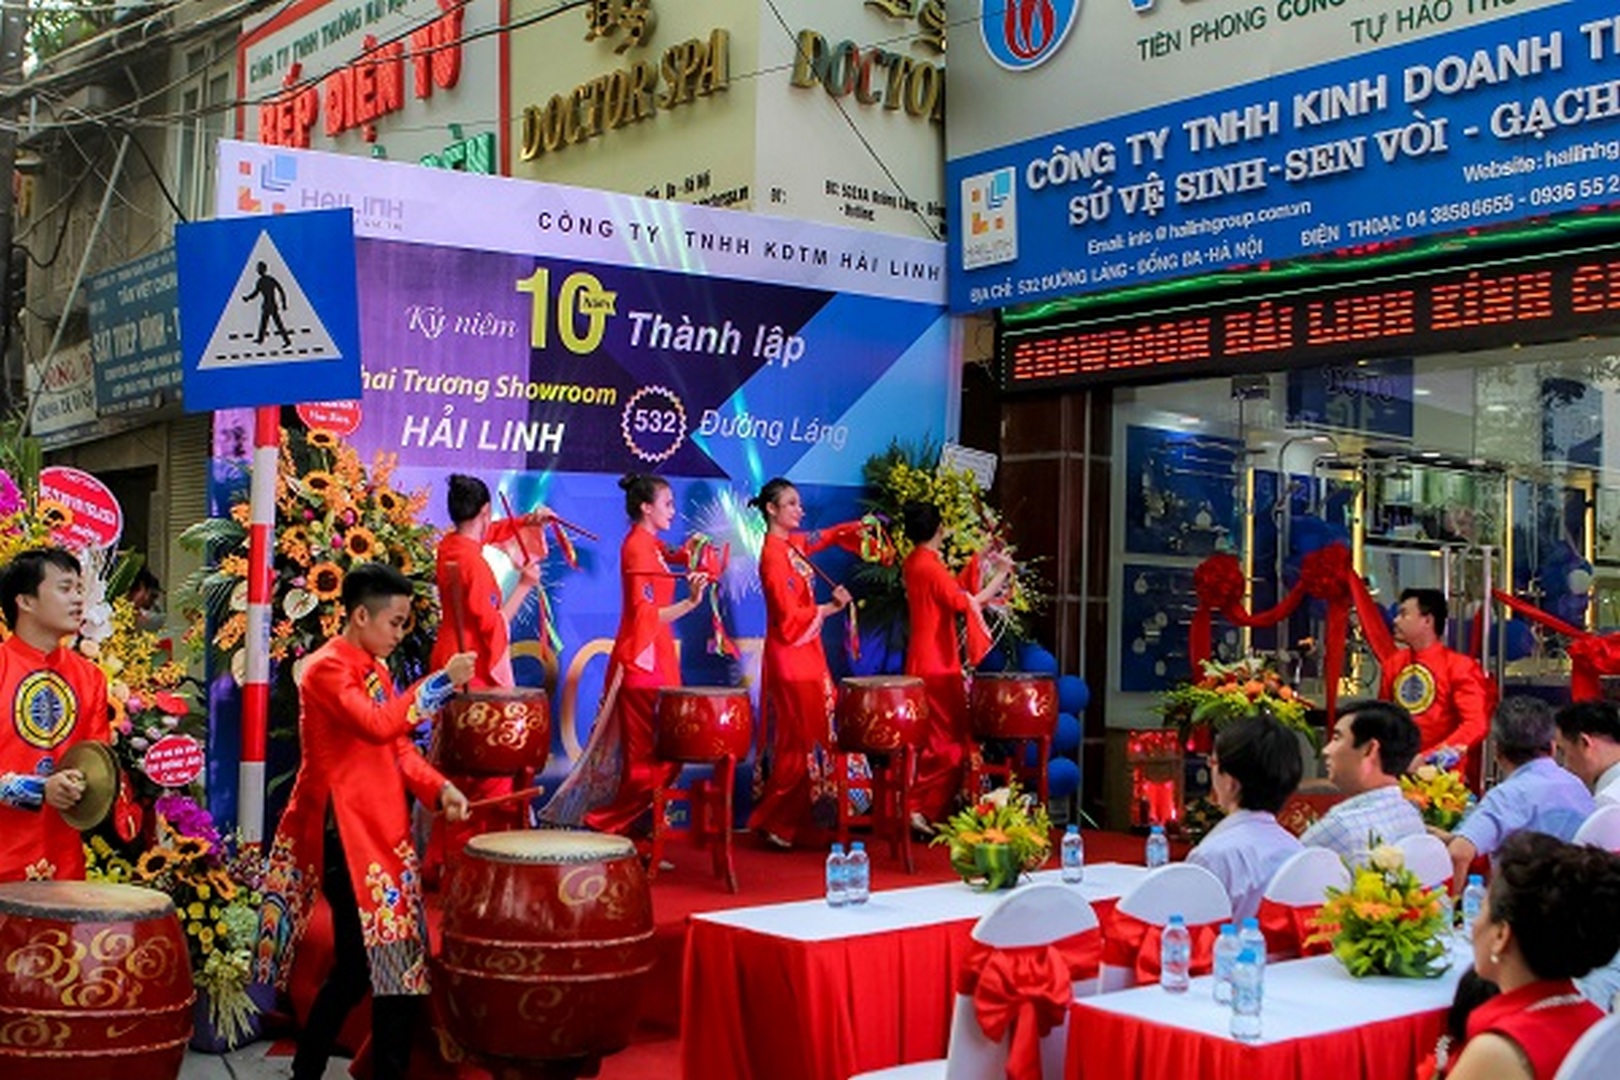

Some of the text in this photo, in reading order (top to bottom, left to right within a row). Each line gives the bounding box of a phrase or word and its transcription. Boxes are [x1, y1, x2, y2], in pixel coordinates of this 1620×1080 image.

[1137, 37, 1180, 61] TIÊN
[1189, 7, 1266, 47] PHONG
[1350, 14, 1387, 44] TỰ
[325, 34, 404, 142] ĐIỆN
[520, 61, 658, 161] DOCTOR
[658, 28, 730, 110] SPA
[1026, 145, 1115, 190] CÔNG
[1126, 128, 1170, 165] TY
[1183, 101, 1280, 152] TNHH
[1293, 74, 1387, 128] KINH
[1404, 31, 1562, 103] DOANH
[1069, 180, 1113, 226] SỨ
[1118, 172, 1165, 217] VỆ
[1373, 110, 1449, 162] VÒI
[1491, 81, 1620, 139] GẠCH
[1301, 222, 1339, 247] ĐIỆN
[1406, 210, 1427, 228] 04
[1530, 181, 1576, 206] 0936
[1580, 177, 1602, 195] 55
[538, 209, 614, 238] CÔNG
[629, 223, 659, 244] TY
[685, 230, 750, 255] TNHH
[764, 242, 828, 266] KDTM
[889, 259, 940, 282] LINH
[454, 311, 519, 338] niệm
[516, 267, 607, 355] 10
[628, 311, 806, 367] Thành lập
[361, 364, 617, 405] hai Trương Showroom
[401, 404, 565, 454] HẢI LINH
[634, 409, 677, 433] 532
[700, 408, 849, 449] Đường Láng
